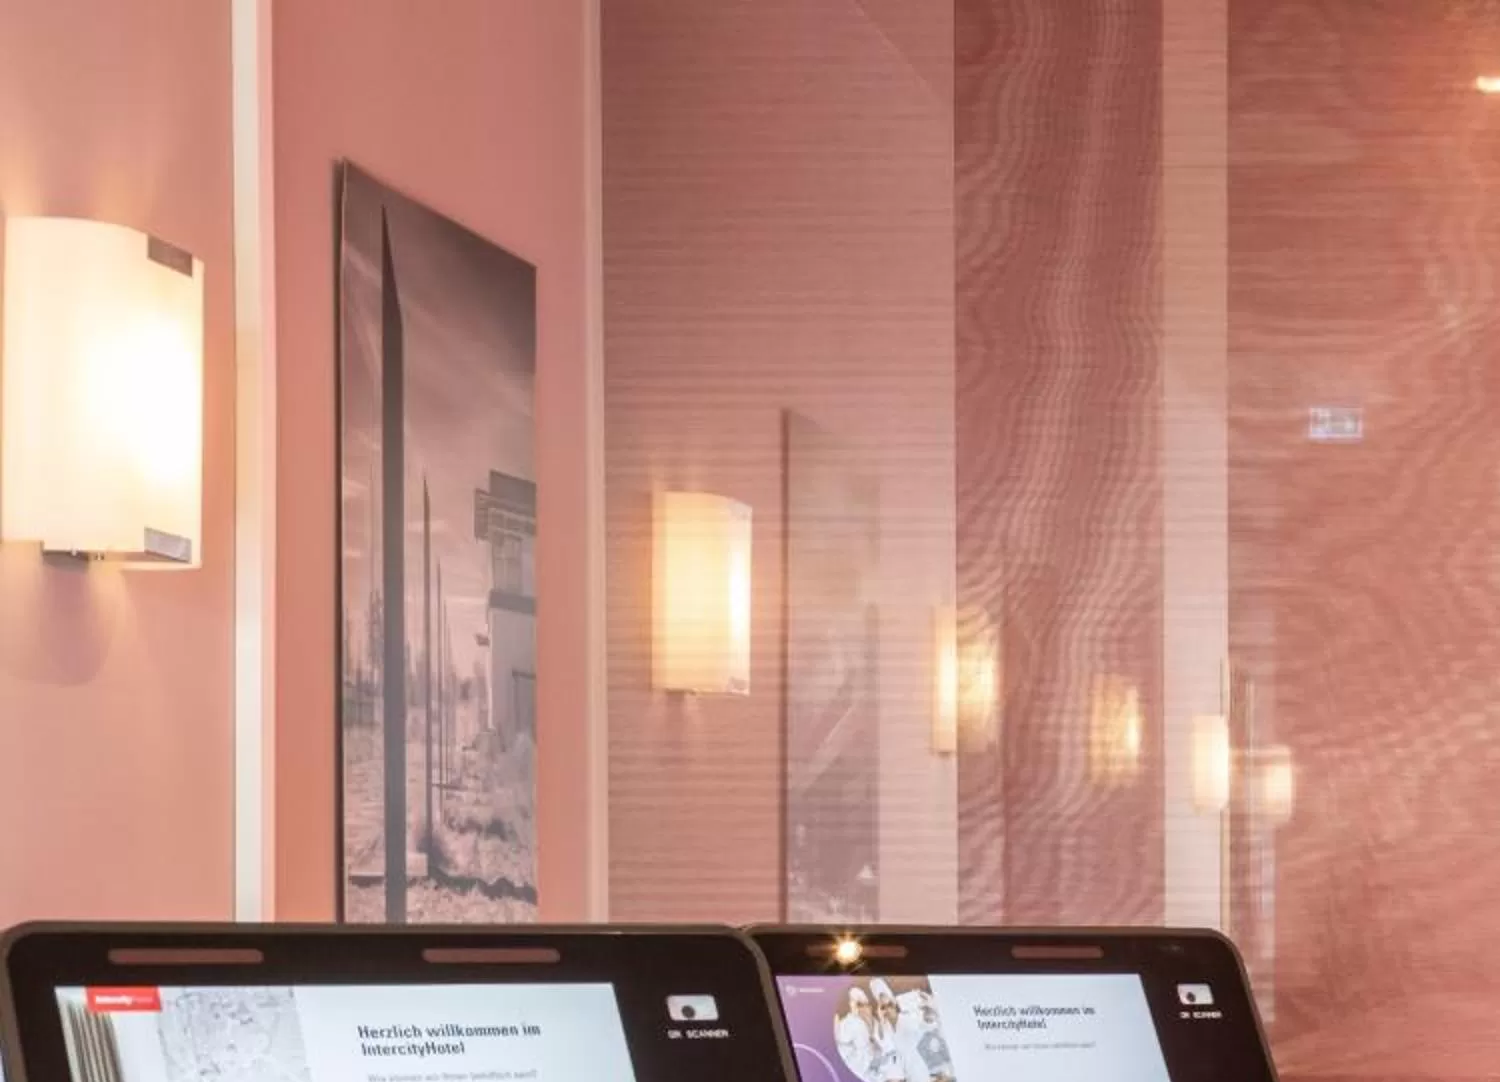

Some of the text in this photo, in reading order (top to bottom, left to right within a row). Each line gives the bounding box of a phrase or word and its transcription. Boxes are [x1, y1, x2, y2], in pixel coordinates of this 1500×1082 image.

[357, 1023, 541, 1039] Herzlich willkommen im
[686, 1029, 729, 1038] SCANNER
[361, 1041, 465, 1058] IntercityHotel
